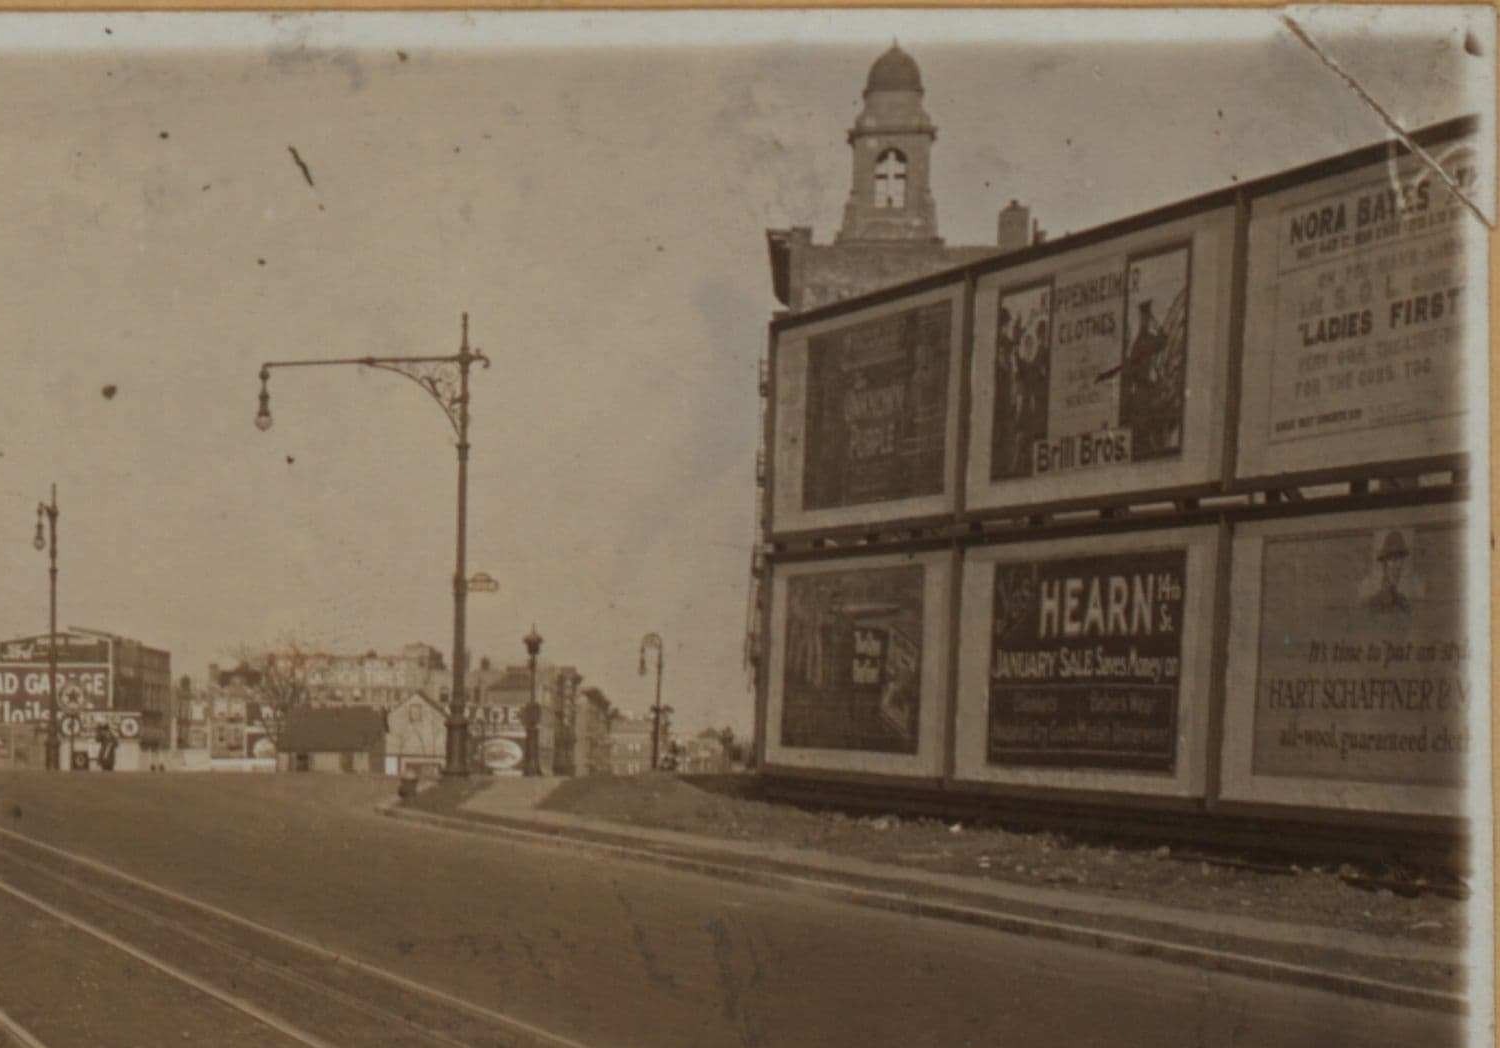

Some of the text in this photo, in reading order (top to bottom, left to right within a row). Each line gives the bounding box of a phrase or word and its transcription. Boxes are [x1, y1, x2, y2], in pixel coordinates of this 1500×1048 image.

[1289, 203, 1347, 245] NORA
[1036, 437, 1075, 473] Brill
[1039, 573, 1156, 640] HEARN
[1059, 647, 1094, 677] SALE
[23, 672, 106, 696] GARGE
[1268, 677, 1321, 711] HART
[1322, 677, 1434, 712] SCHAFFNER
